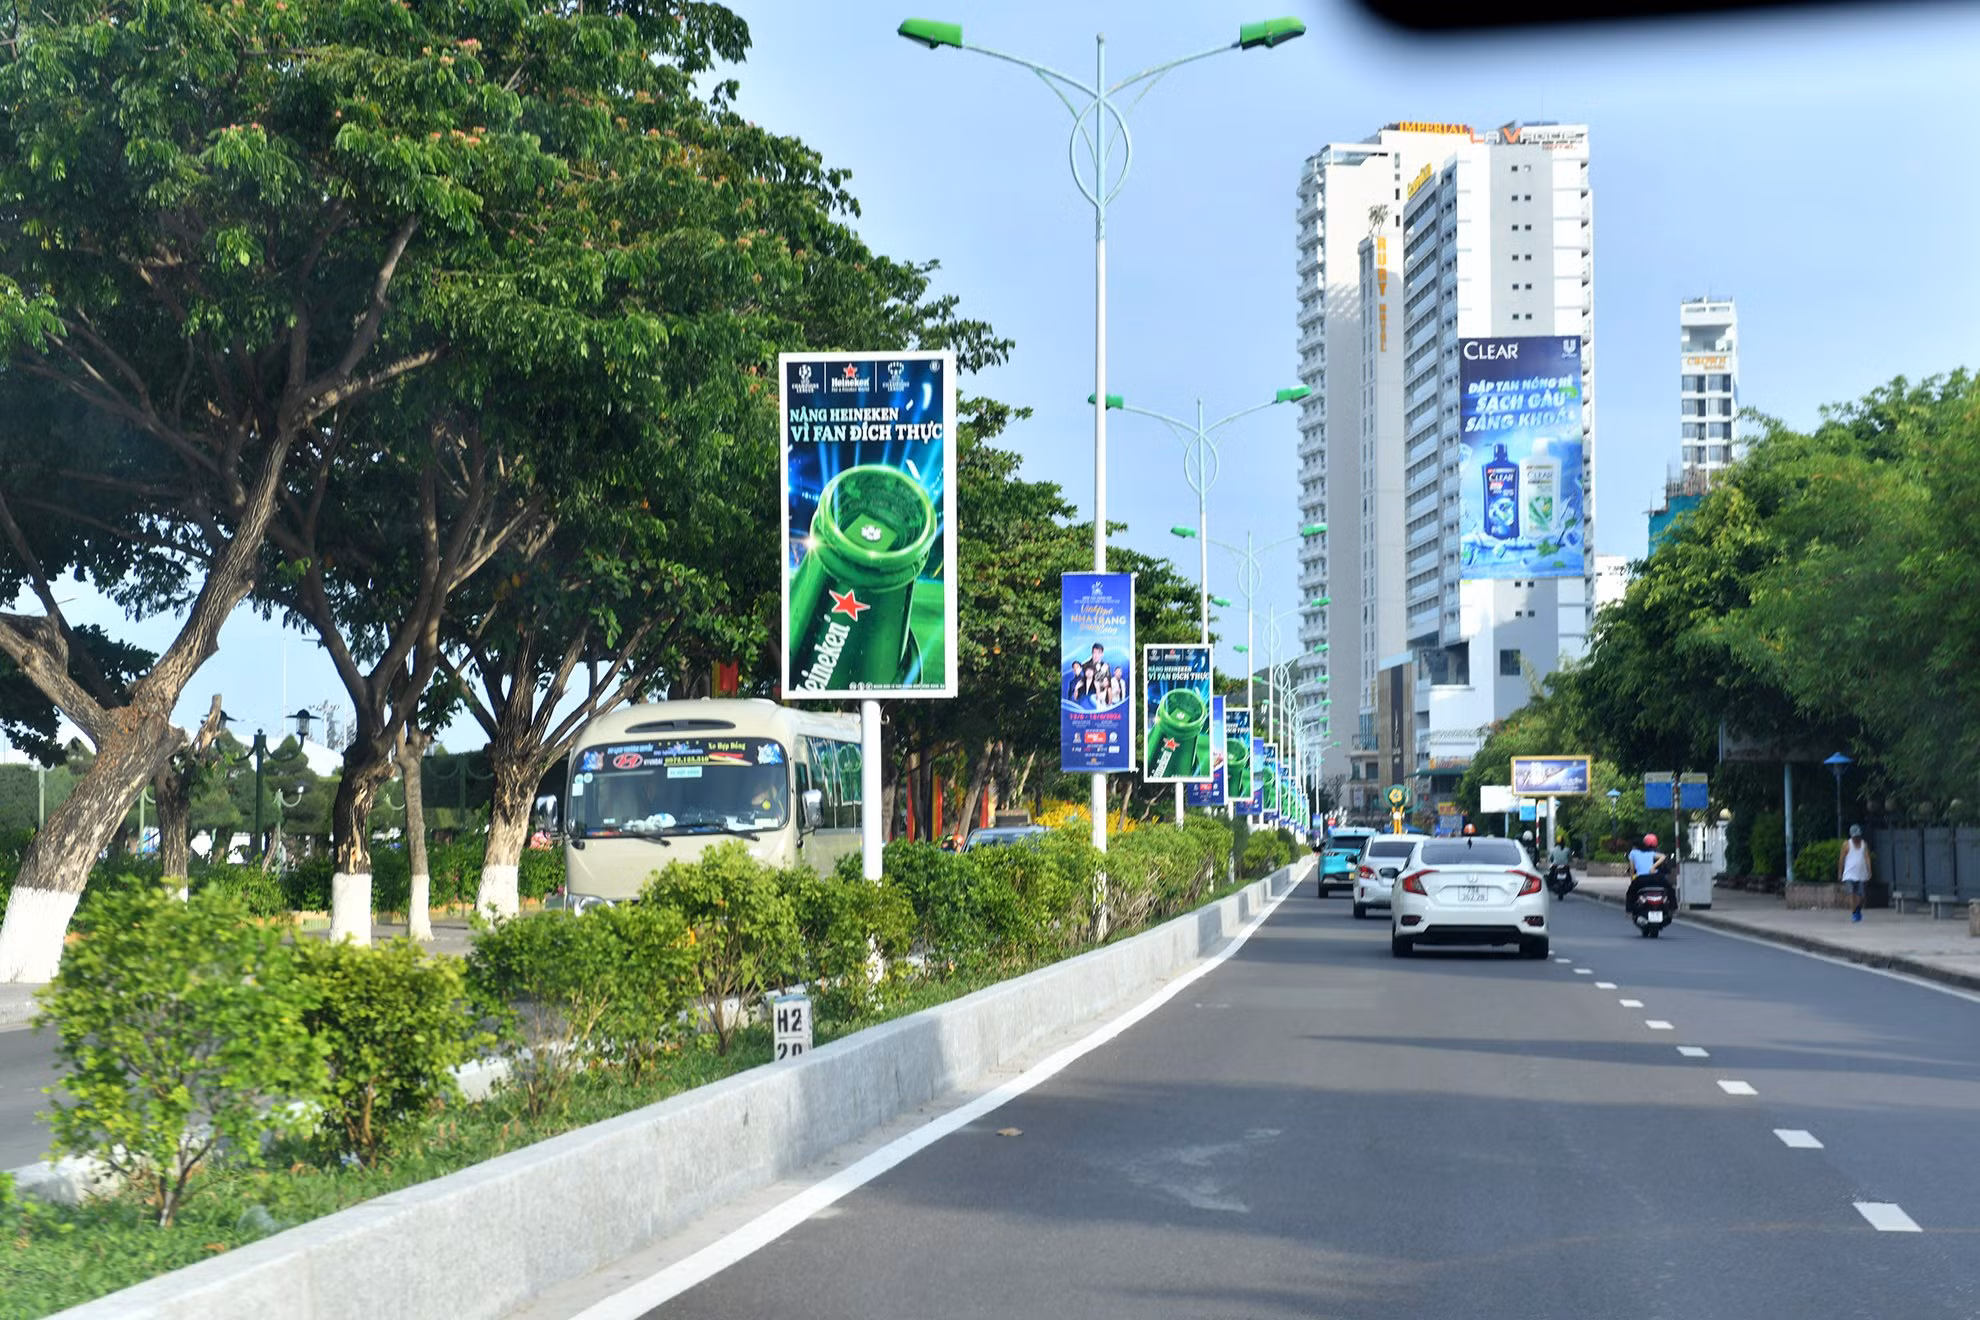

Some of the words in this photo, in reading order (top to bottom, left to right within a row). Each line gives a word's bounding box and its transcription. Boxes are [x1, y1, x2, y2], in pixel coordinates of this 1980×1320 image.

[1400, 122, 1468, 135] IMPERIAL
[1463, 341, 1518, 360] CLEAR
[831, 377, 870, 387] Heineken
[1496, 380, 1519, 392] TAN
[830, 408, 899, 422] HEINEKEN
[791, 422, 810, 442] VÌ
[813, 425, 846, 442] FAN
[850, 421, 892, 441] ĐÍCH
[895, 420, 943, 444] THỰC
[777, 1008, 802, 1032] H2
